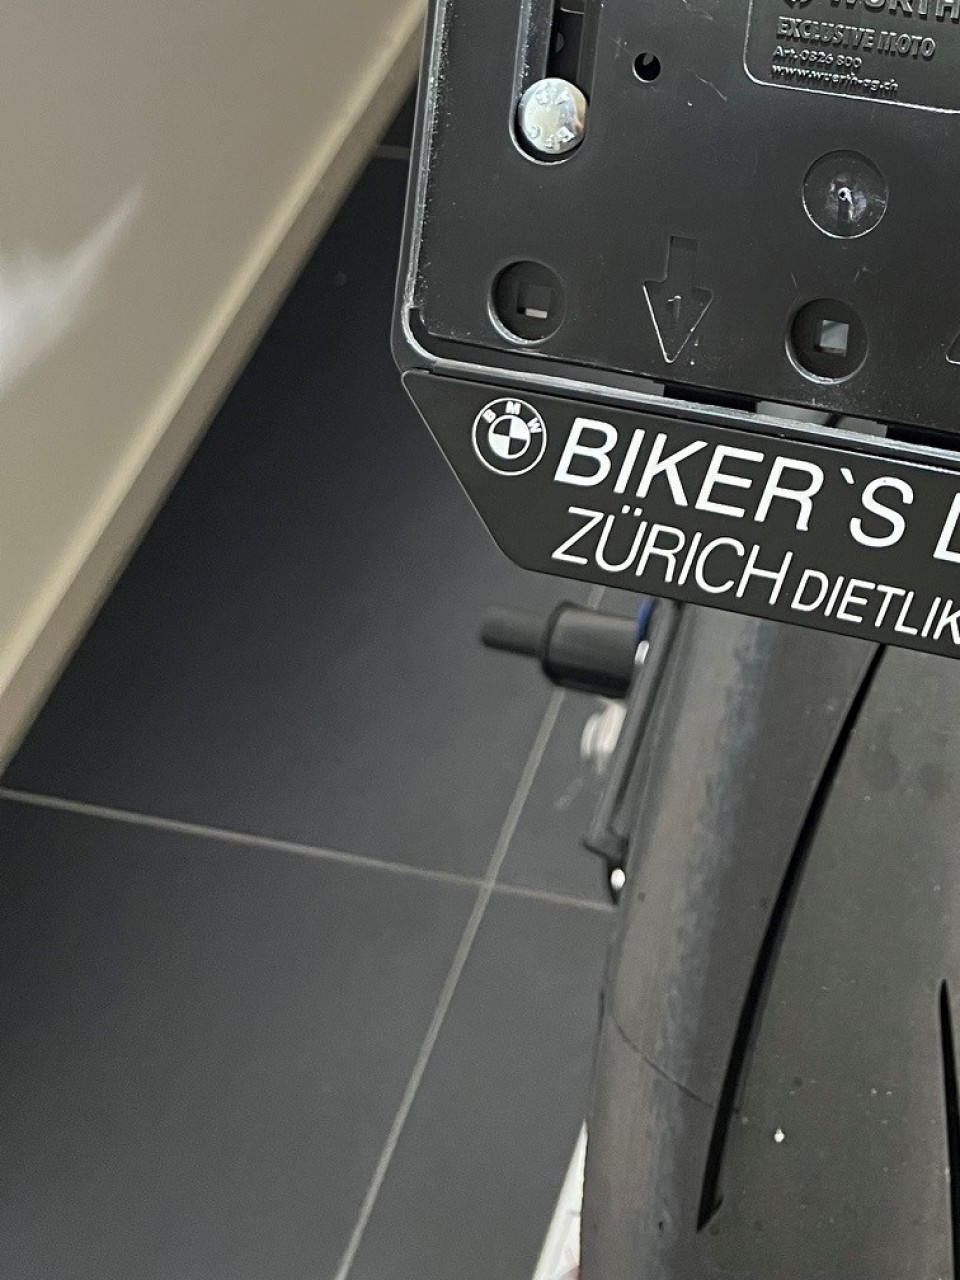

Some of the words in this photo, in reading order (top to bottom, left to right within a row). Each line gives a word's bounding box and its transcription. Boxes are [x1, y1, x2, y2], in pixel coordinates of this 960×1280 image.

[776, 16, 875, 50] EXCLUSIVE
[877, 30, 936, 58] MOTO
[551, 504, 793, 605] ZÜRICH
